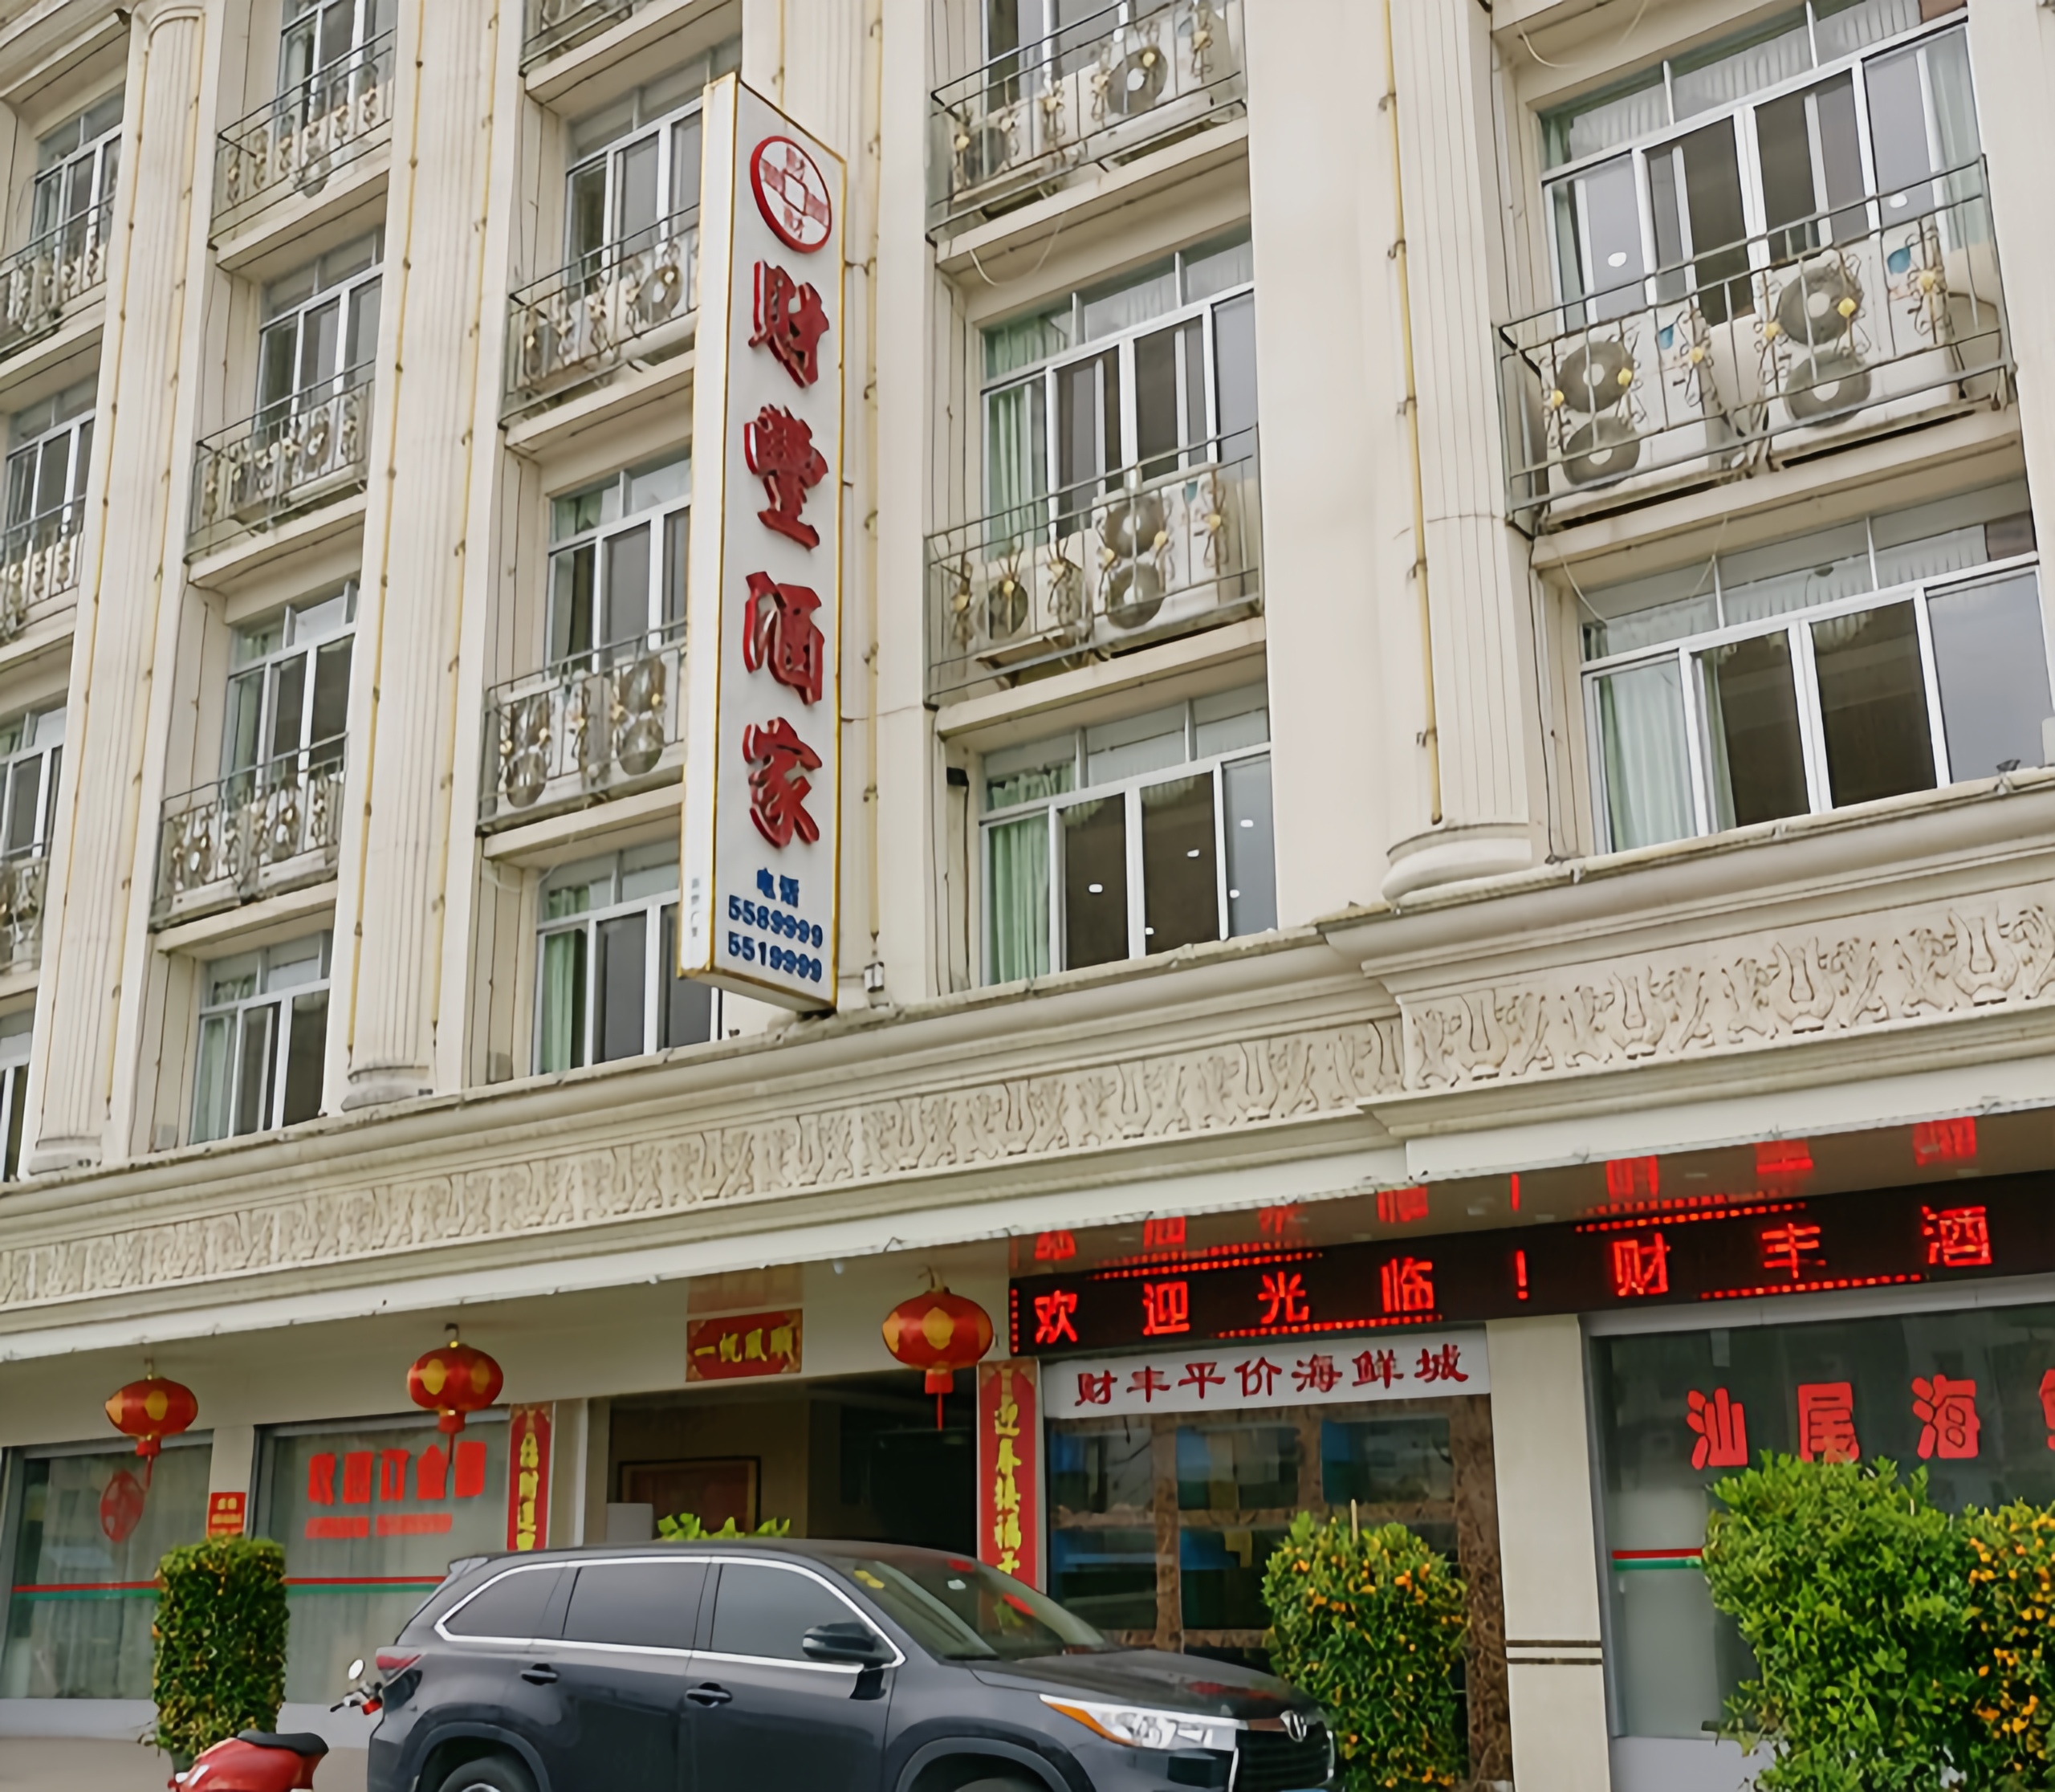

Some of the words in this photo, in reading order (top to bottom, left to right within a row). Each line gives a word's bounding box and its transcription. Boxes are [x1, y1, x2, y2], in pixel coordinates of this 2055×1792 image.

[729, 894, 823, 948] 5589999
[729, 931, 822, 983] 5519999
[1075, 1344, 1469, 1407] 财丰平价海鲜城
